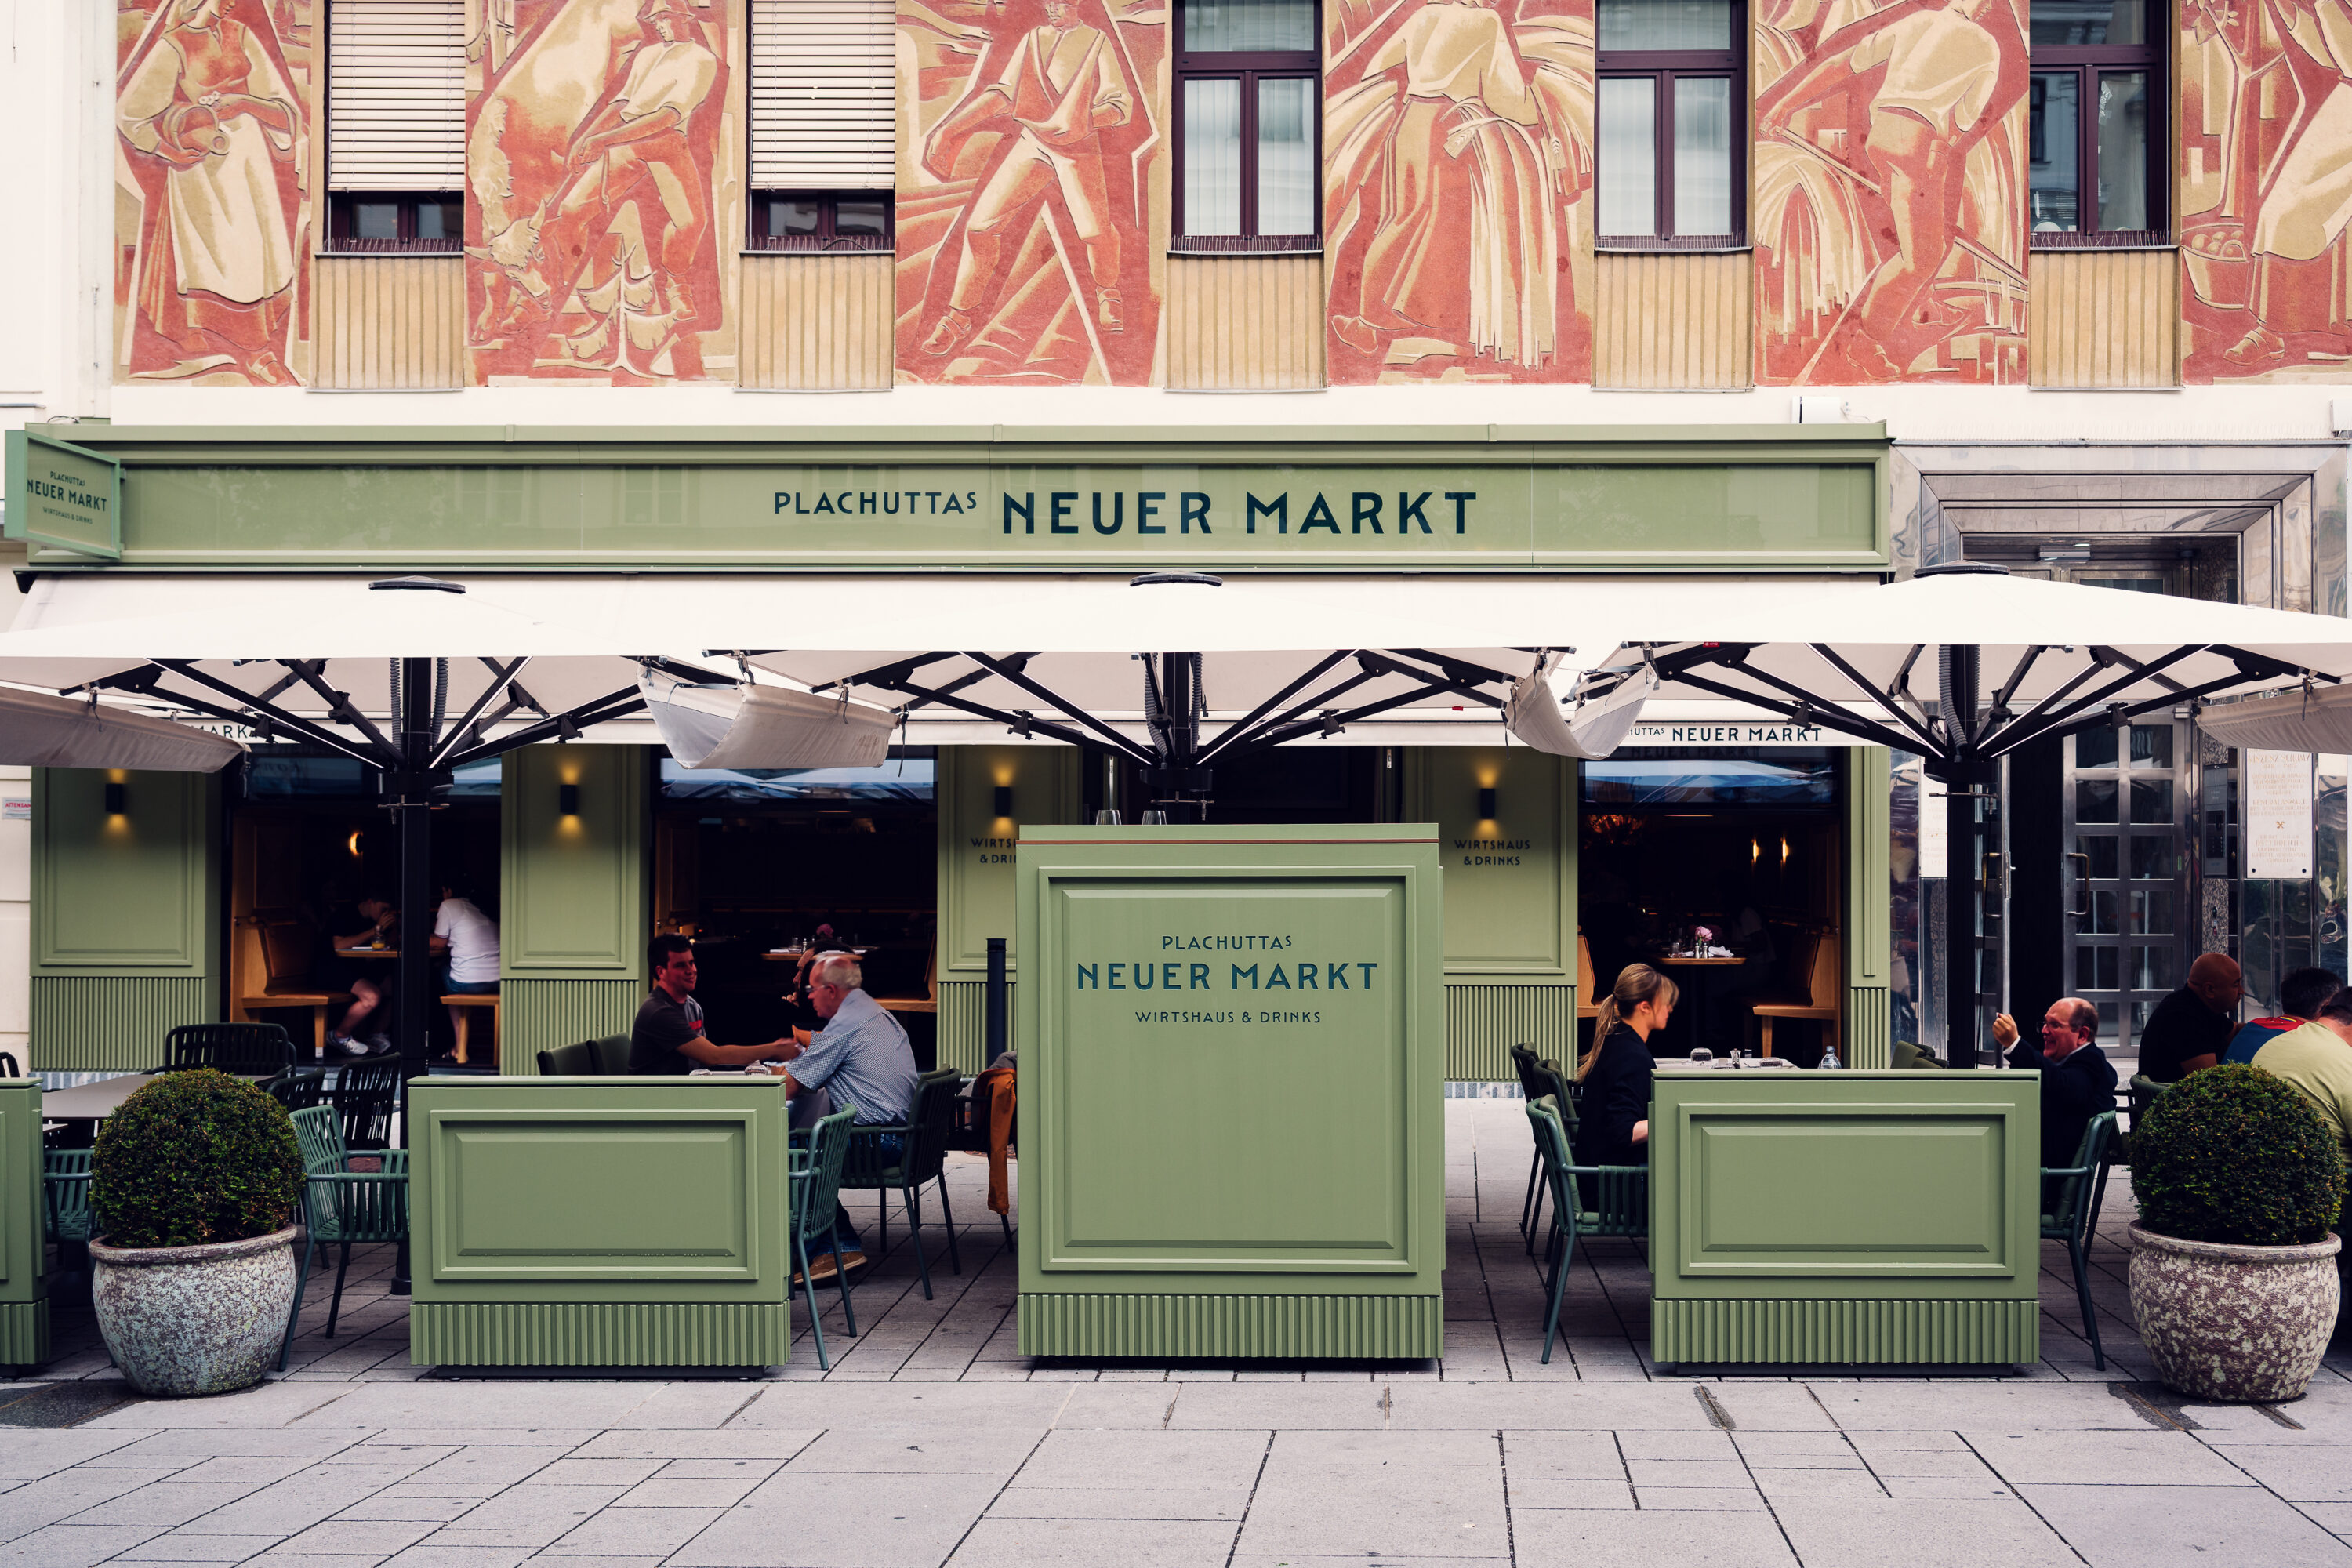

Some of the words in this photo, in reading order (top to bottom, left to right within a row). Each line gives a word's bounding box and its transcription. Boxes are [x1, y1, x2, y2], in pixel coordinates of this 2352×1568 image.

[50, 471, 85, 487] PLACHUTTAS
[27, 479, 64, 501] NEUER
[68, 490, 107, 512] MARKT
[43, 507, 71, 519] WIRTSHAUS
[775, 491, 977, 515] PLACHUTTAS
[1003, 492, 1213, 535] NEUER
[1246, 491, 1477, 535] MARKT
[199, 725, 258, 739] ARK
[1627, 727, 1665, 736] HUTTAS
[1672, 727, 1739, 742] NEUER
[1748, 727, 1822, 742] MARKT
[1453, 838, 1531, 850] WIRTSHAUS
[979, 854, 989, 864] &
[991, 855, 1017, 864] DRI
[1463, 855, 1473, 866] &
[1475, 855, 1522, 866] DRINKS
[1162, 935, 1292, 950] PLACHUTTAS
[1077, 963, 1210, 990] NEUER
[1231, 963, 1377, 990] MARKT
[1134, 1011, 1234, 1023] WIRTSHAUS
[1241, 1011, 1253, 1023] &
[1260, 1011, 1320, 1023] DRINKS
